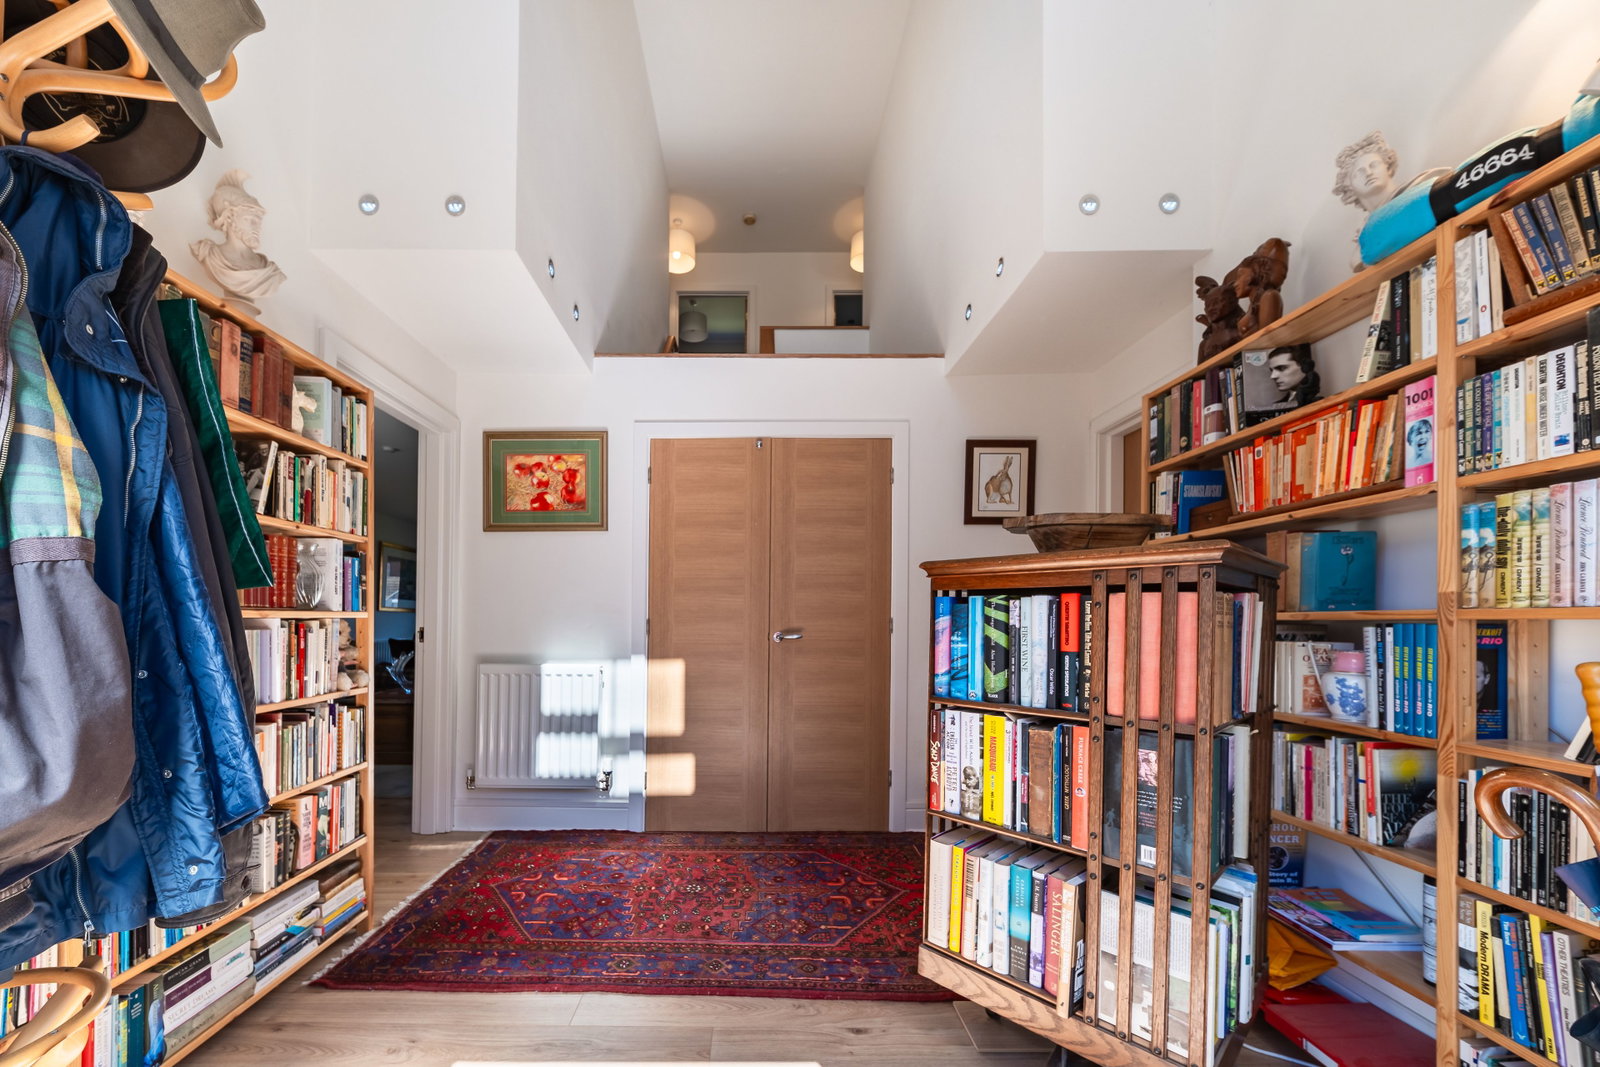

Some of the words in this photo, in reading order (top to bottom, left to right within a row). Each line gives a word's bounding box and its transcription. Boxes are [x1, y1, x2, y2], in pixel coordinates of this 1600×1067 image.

[1455, 143, 1535, 189] 46664
[1541, 208, 1550, 216] AND
[1586, 228, 1597, 250] Fleming
[1539, 359, 1548, 385] DEIGHTON
[1556, 352, 1566, 391] DEIGHTON
[1406, 388, 1433, 405] 1001
[1539, 386, 1548, 403] HORSE
[1539, 403, 1548, 419] UNDER
[1539, 420, 1548, 437] WATER
[1498, 506, 1511, 517] the
[1554, 500, 1568, 525] Licence
[1578, 497, 1594, 522] Licence
[1497, 521, 1511, 537] dolly
[1497, 539, 1511, 555] dolly
[1554, 528, 1567, 562] Renewed
[1579, 525, 1593, 560] Renewed
[1497, 557, 1509, 568] spy
[1084, 601, 1092, 614] Leave
[1476, 628, 1503, 636] ERKOFF
[930, 739, 941, 761] SCALP
[989, 736, 997, 772] MASQUERADE
[930, 761, 940, 786] DANCE
[1272, 823, 1302, 832] HOU
[1269, 835, 1300, 844] NCER
[1050, 891, 1062, 956] SALINGER
[1480, 930, 1488, 962] Modern
[1557, 937, 1567, 962] OTHER
[1481, 963, 1489, 996] DRAMA
[1559, 962, 1570, 997] THEATRES
